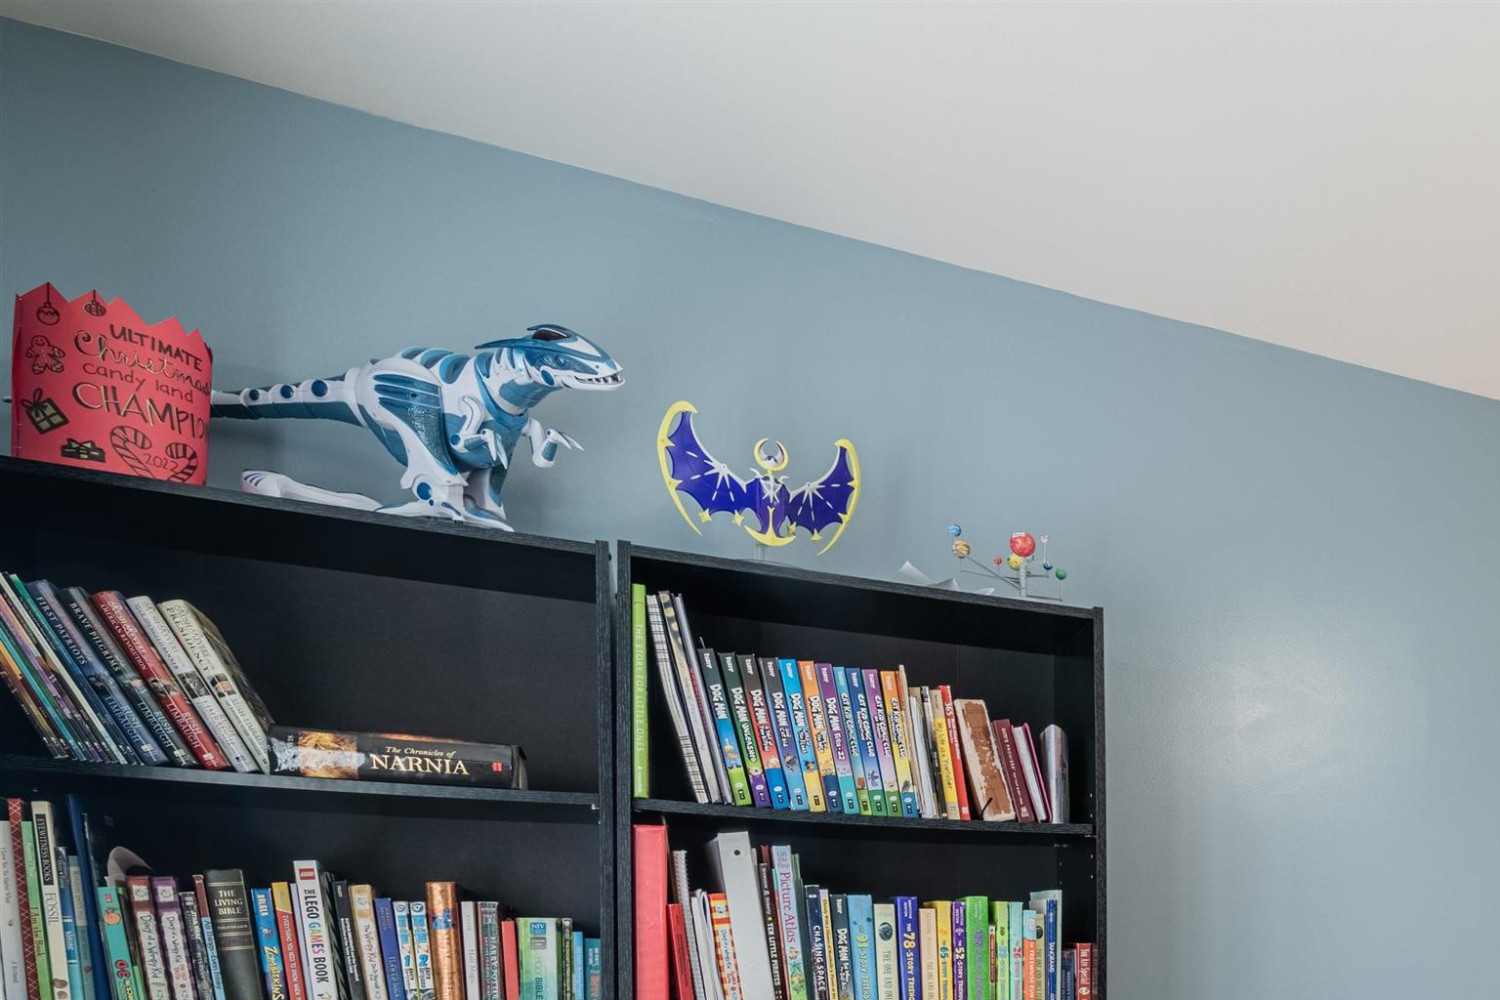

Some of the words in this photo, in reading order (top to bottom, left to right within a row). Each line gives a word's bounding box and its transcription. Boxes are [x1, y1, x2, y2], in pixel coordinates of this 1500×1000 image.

[110, 324, 203, 372] ULTIMATE
[83, 362, 146, 391] candy
[155, 379, 194, 404] land
[72, 382, 208, 440] CHAMPIO
[144, 453, 179, 471] 2022
[35, 594, 58, 624] FIRST
[54, 622, 87, 666] PATRIOTS
[69, 600, 92, 630] BRAVE
[89, 630, 121, 673] PILGRIMS
[165, 604, 209, 675] PRESIDENCY
[633, 624, 642, 639] THE
[633, 644, 643, 671] STORY
[634, 675, 644, 692] FOR
[709, 683, 723, 701] DOG
[730, 686, 743, 704] DOG
[749, 688, 764, 707] DOG
[824, 696, 838, 714] DOG
[104, 694, 140, 744] LIMBAUGH
[635, 695, 645, 722] LITTLE
[713, 700, 727, 720] MAN
[734, 704, 748, 723] MAN
[753, 706, 768, 725] MAN
[944, 701, 953, 716] 365
[136, 700, 173, 749] LIMBAUGH
[153, 708, 174, 735] RUSH
[165, 701, 201, 749] LIMBAUGH
[828, 713, 841, 732] MAN
[636, 727, 646, 751] ONES
[404, 747, 444, 757] Chronicles
[446, 750, 456, 758] of
[370, 754, 470, 776] NARNIA
[37, 818, 48, 858] EYEWITNESS
[41, 859, 51, 881] BOOKS
[217, 889, 236, 899] THE
[779, 871, 793, 911] Picture
[214, 898, 243, 908] LIVING
[218, 906, 242, 916] BIBLE
[304, 895, 320, 919] LEGO
[308, 921, 324, 954] GAMES
[766, 923, 774, 934] TEN
[784, 912, 797, 943] Atlas
[836, 927, 848, 943] DOG
[768, 936, 777, 958] LITTLE
[811, 924, 823, 962] CHASING
[837, 944, 849, 961] MAN
[1080, 948, 1089, 957] You
[882, 950, 891, 962] THE
[1080, 958, 1089, 966] Are
[313, 956, 328, 983] BOOK
[771, 959, 780, 985] PIRATES
[815, 965, 826, 991] SPACE
[883, 963, 892, 976] ONE
[1079, 967, 1088, 984] Special
[883, 977, 892, 989] AND
